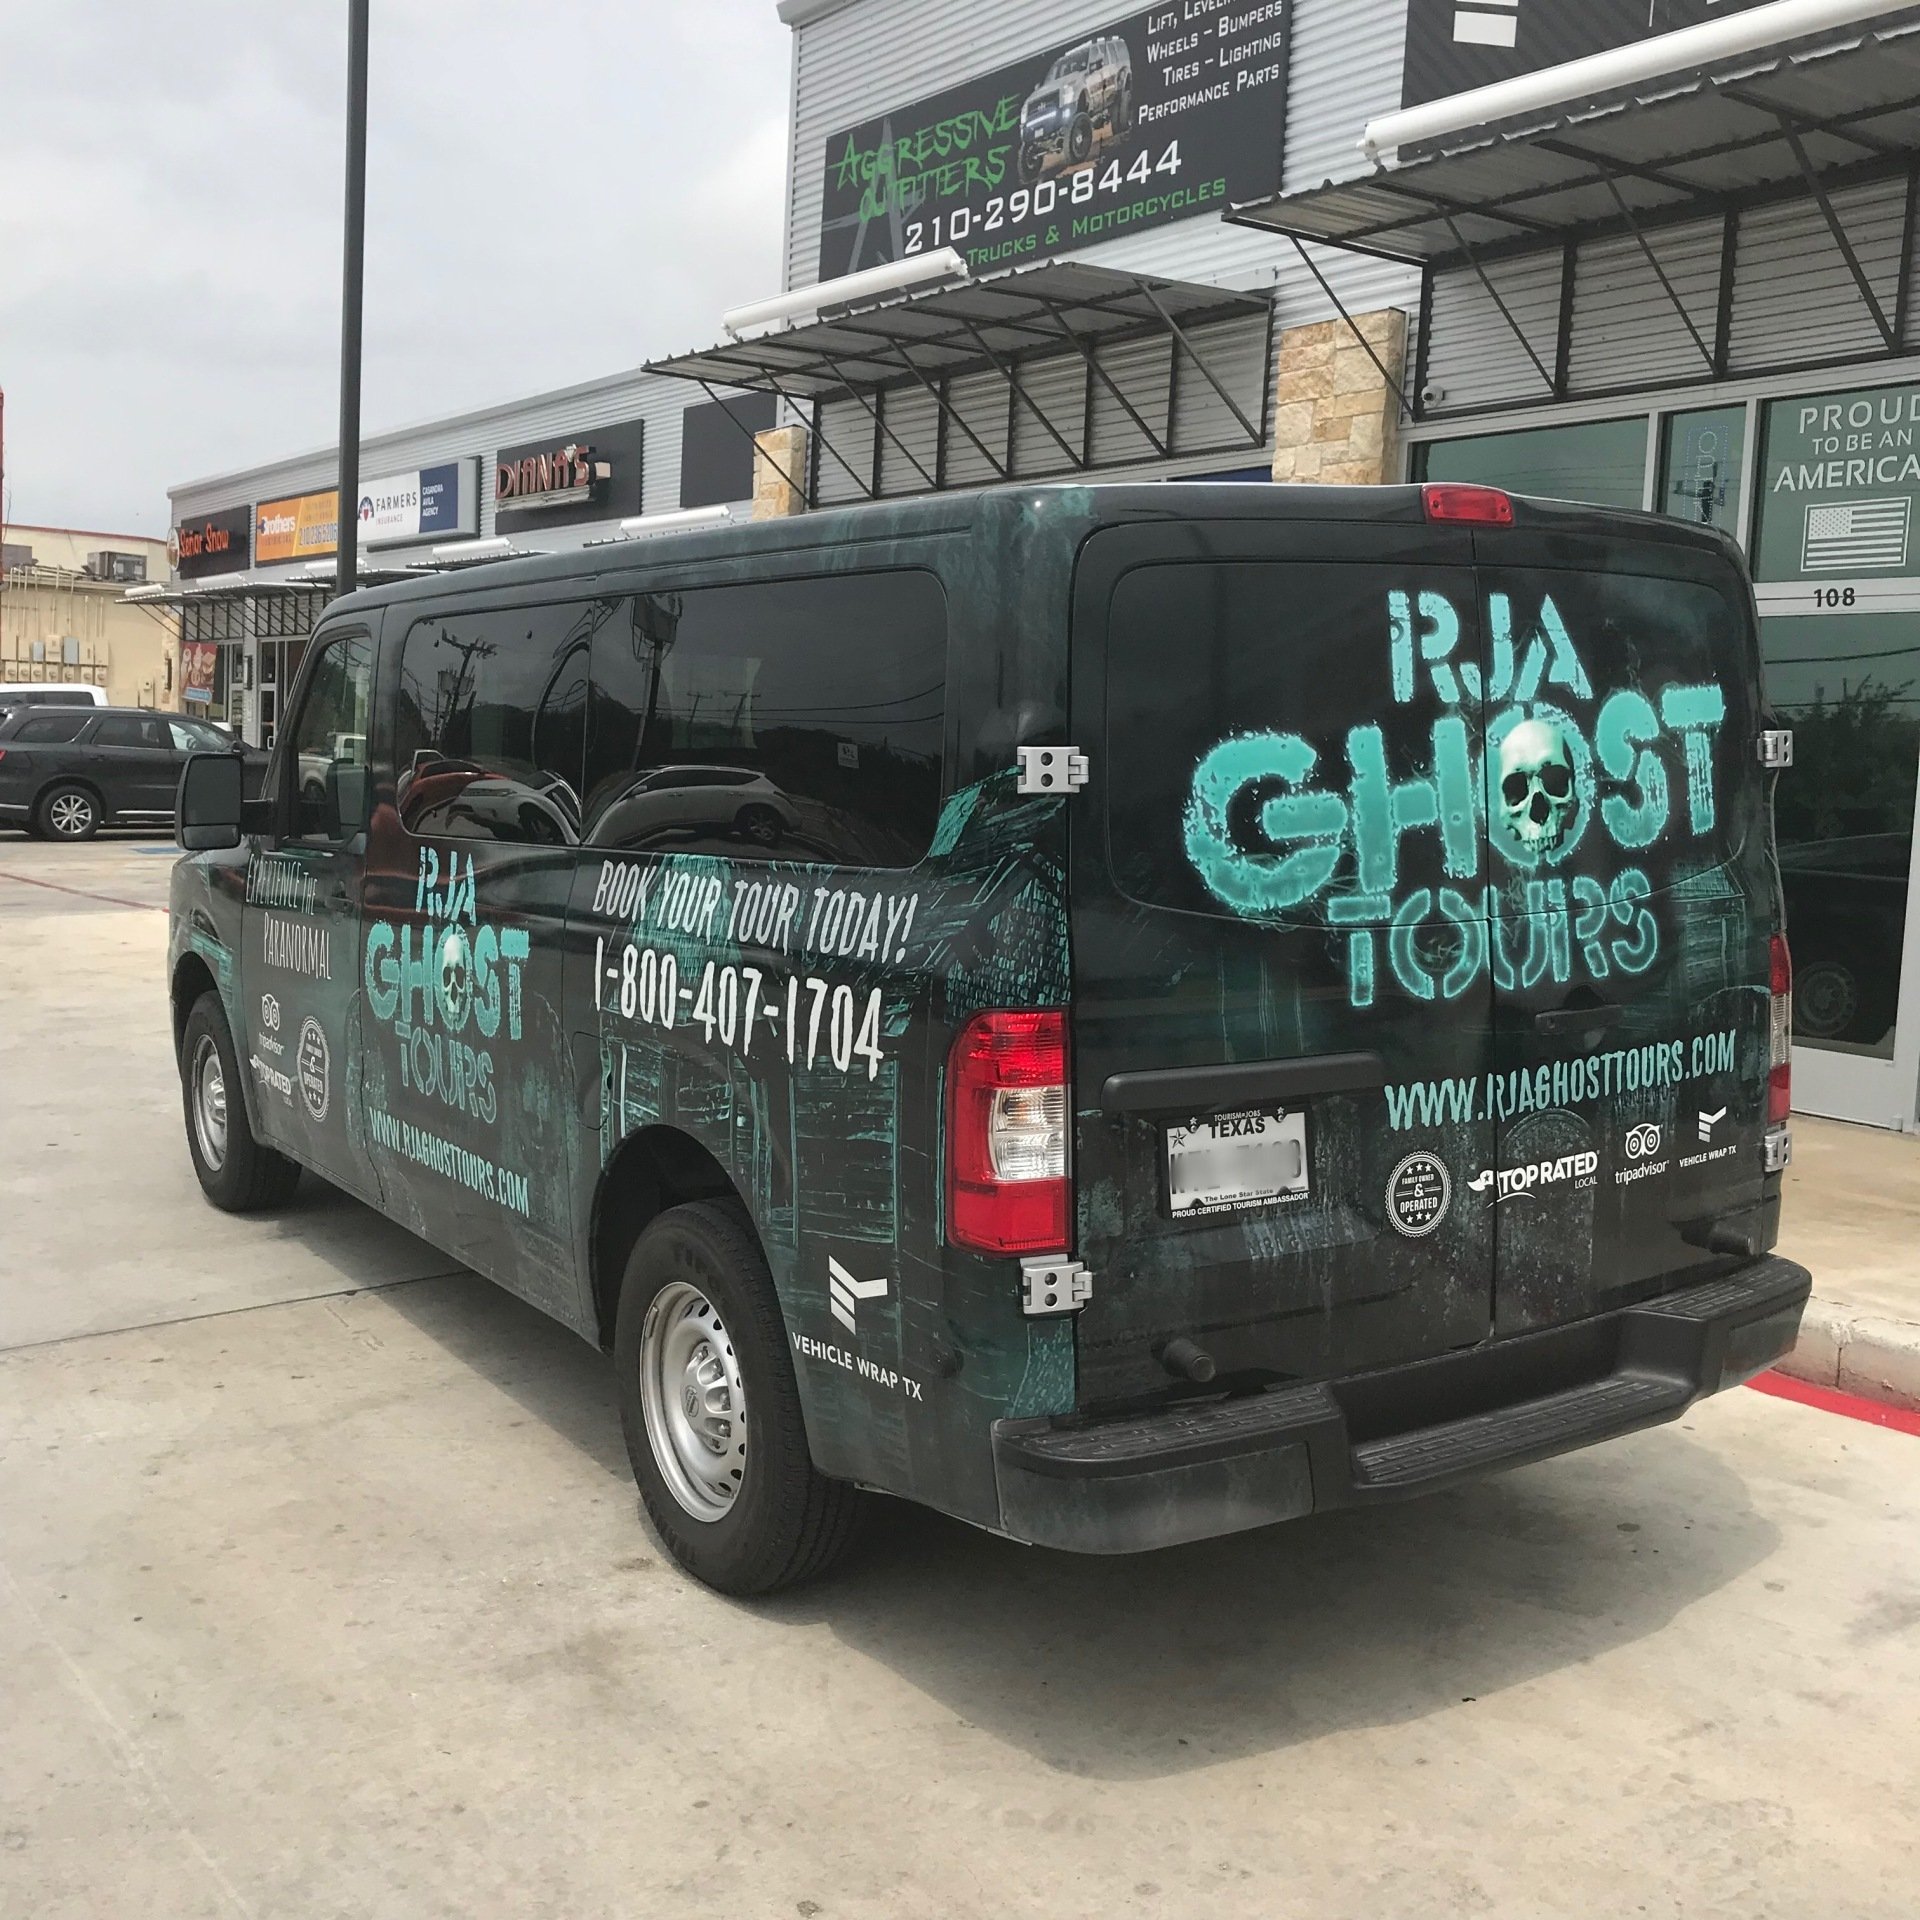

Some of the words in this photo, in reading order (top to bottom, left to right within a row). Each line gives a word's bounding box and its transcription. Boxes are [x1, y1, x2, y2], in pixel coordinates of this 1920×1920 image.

[1147, 33, 1198, 63] WHEELS
[1218, 1, 1282, 37] BUMPERS
[1163, 62, 1199, 86] TIRES
[1219, 32, 1281, 67] LIGHTING
[1138, 81, 1230, 125] PERFORMANCE
[1237, 64, 1279, 92] PARTS
[825, 93, 1020, 191] AGGRESSIVE
[905, 139, 1182, 254] 210-290-8444
[967, 234, 1037, 267] TRUCKS
[1045, 225, 1060, 246] &
[1072, 178, 1226, 238] MOTORCYCLES
[1812, 436, 1839, 455] TO
[1846, 433, 1872, 451] BE
[1879, 428, 1912, 449] AN
[376, 492, 417, 512] FARMERS
[376, 514, 403, 526] INSURANCE
[422, 507, 439, 517] AGENCY
[1813, 587, 1856, 607] 108
[1387, 590, 1593, 703] RJA
[1182, 683, 1725, 913] GHOST
[246, 853, 301, 908] EXPERIENCE
[301, 872, 318, 915] THE
[415, 845, 476, 926] RJA
[593, 859, 656, 921] BOOK
[657, 871, 722, 946] YOUR
[727, 879, 799, 957] TOUR
[806, 886, 918, 964] TODAY!
[264, 911, 331, 979] PARANORMAL
[1327, 867, 1658, 1007] TOURS
[365, 919, 530, 1041] GHOST
[594, 936, 884, 1081] 1-800-407-1704
[395, 1020, 497, 1124] TOURS
[1384, 1029, 1737, 1131] WWW.RJAGHOSTTOURS.COM
[1208, 1116, 1265, 1139] TEXAS
[1679, 1153, 1707, 1168] VEHICLE
[1708, 1148, 1727, 1161] WRAP
[1728, 1145, 1737, 1155] TX
[369, 1106, 530, 1218] WWW.RJAGHOSTTOURS.COM
[1239, 1190, 1253, 1198] Star
[1255, 1188, 1274, 1196] State
[1414, 1183, 1424, 1197] &
[1499, 1165, 1539, 1194] TOP
[1540, 1151, 1598, 1184] RATED
[1575, 1176, 1598, 1189] LOCAL
[1615, 1160, 1667, 1185] tripadvisor
[1172, 1209, 1196, 1219] PROUD
[1197, 1203, 1232, 1215] CERTIFIED
[1233, 1199, 1262, 1210] TOURISM
[1263, 1193, 1308, 1206] AMBASSADOR
[1400, 1196, 1437, 1213] OPERATED
[792, 1332, 853, 1370] VEHICLE
[856, 1356, 898, 1389] WRAP
[902, 1376, 923, 1402] TX
